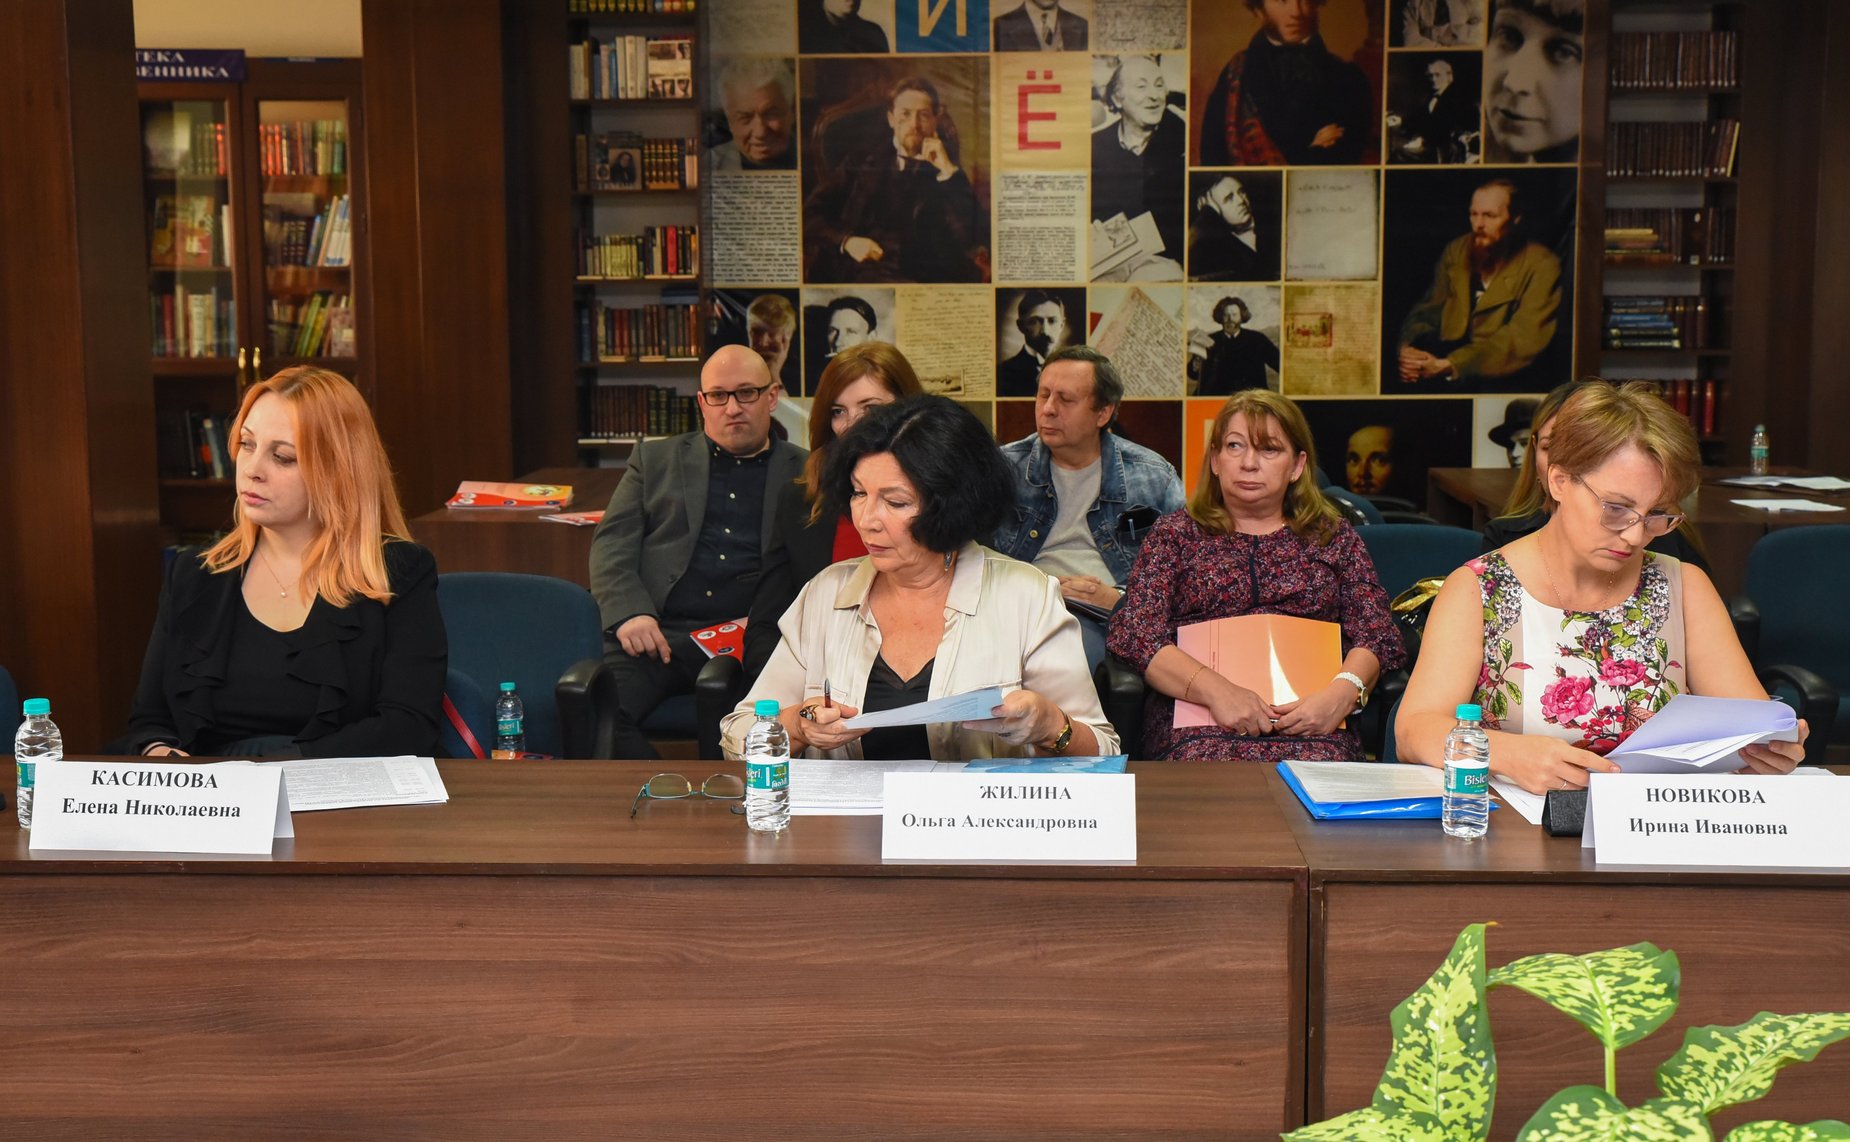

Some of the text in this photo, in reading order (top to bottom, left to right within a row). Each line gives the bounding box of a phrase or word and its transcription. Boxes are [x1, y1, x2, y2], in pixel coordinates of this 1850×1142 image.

[1018, 70, 1061, 150] Ё
[91, 769, 219, 789] КАСИМОВА
[980, 785, 1072, 800] ЖИЛИНА
[1646, 787, 1766, 804] НОВИКОВА
[62, 797, 241, 818] Елена Николаевна
[902, 813, 1098, 832] Ольга Александровна
[1630, 817, 1788, 837] Ирина Ивановна
